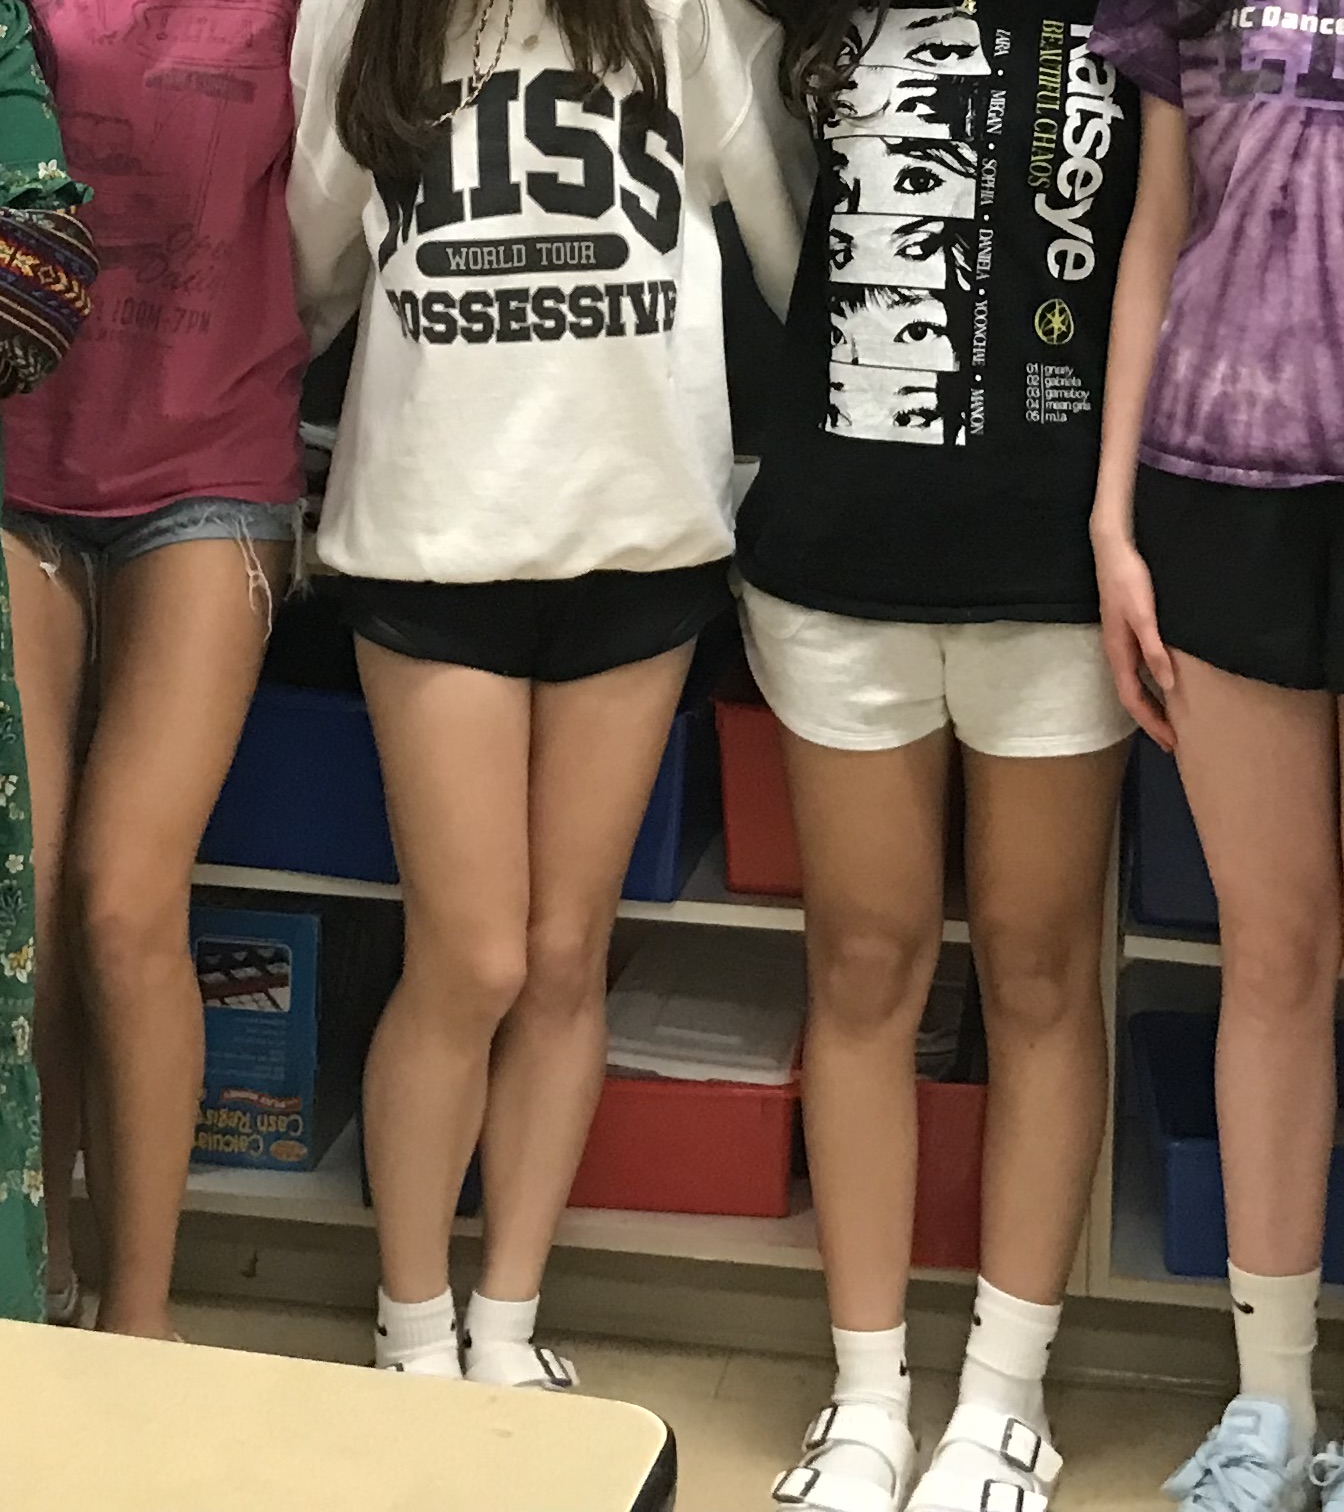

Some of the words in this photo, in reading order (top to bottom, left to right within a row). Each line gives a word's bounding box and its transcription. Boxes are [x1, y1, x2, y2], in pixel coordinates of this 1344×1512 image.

[1036, 19, 1065, 114] BEAUTIFUL
[988, 89, 1008, 135] MEGAN
[1027, 117, 1058, 189] CHAOS
[980, 159, 998, 208] SOPHIA
[446, 245, 526, 271] WORLD
[536, 241, 596, 266] TOUR
[975, 228, 995, 282] DANIELA
[1026, 363, 1038, 374] 01
[1026, 375, 1040, 386] 02
[969, 388, 985, 435] MANON
[1026, 387, 1040, 398] 03
[256, 1114, 304, 1137] Cash
